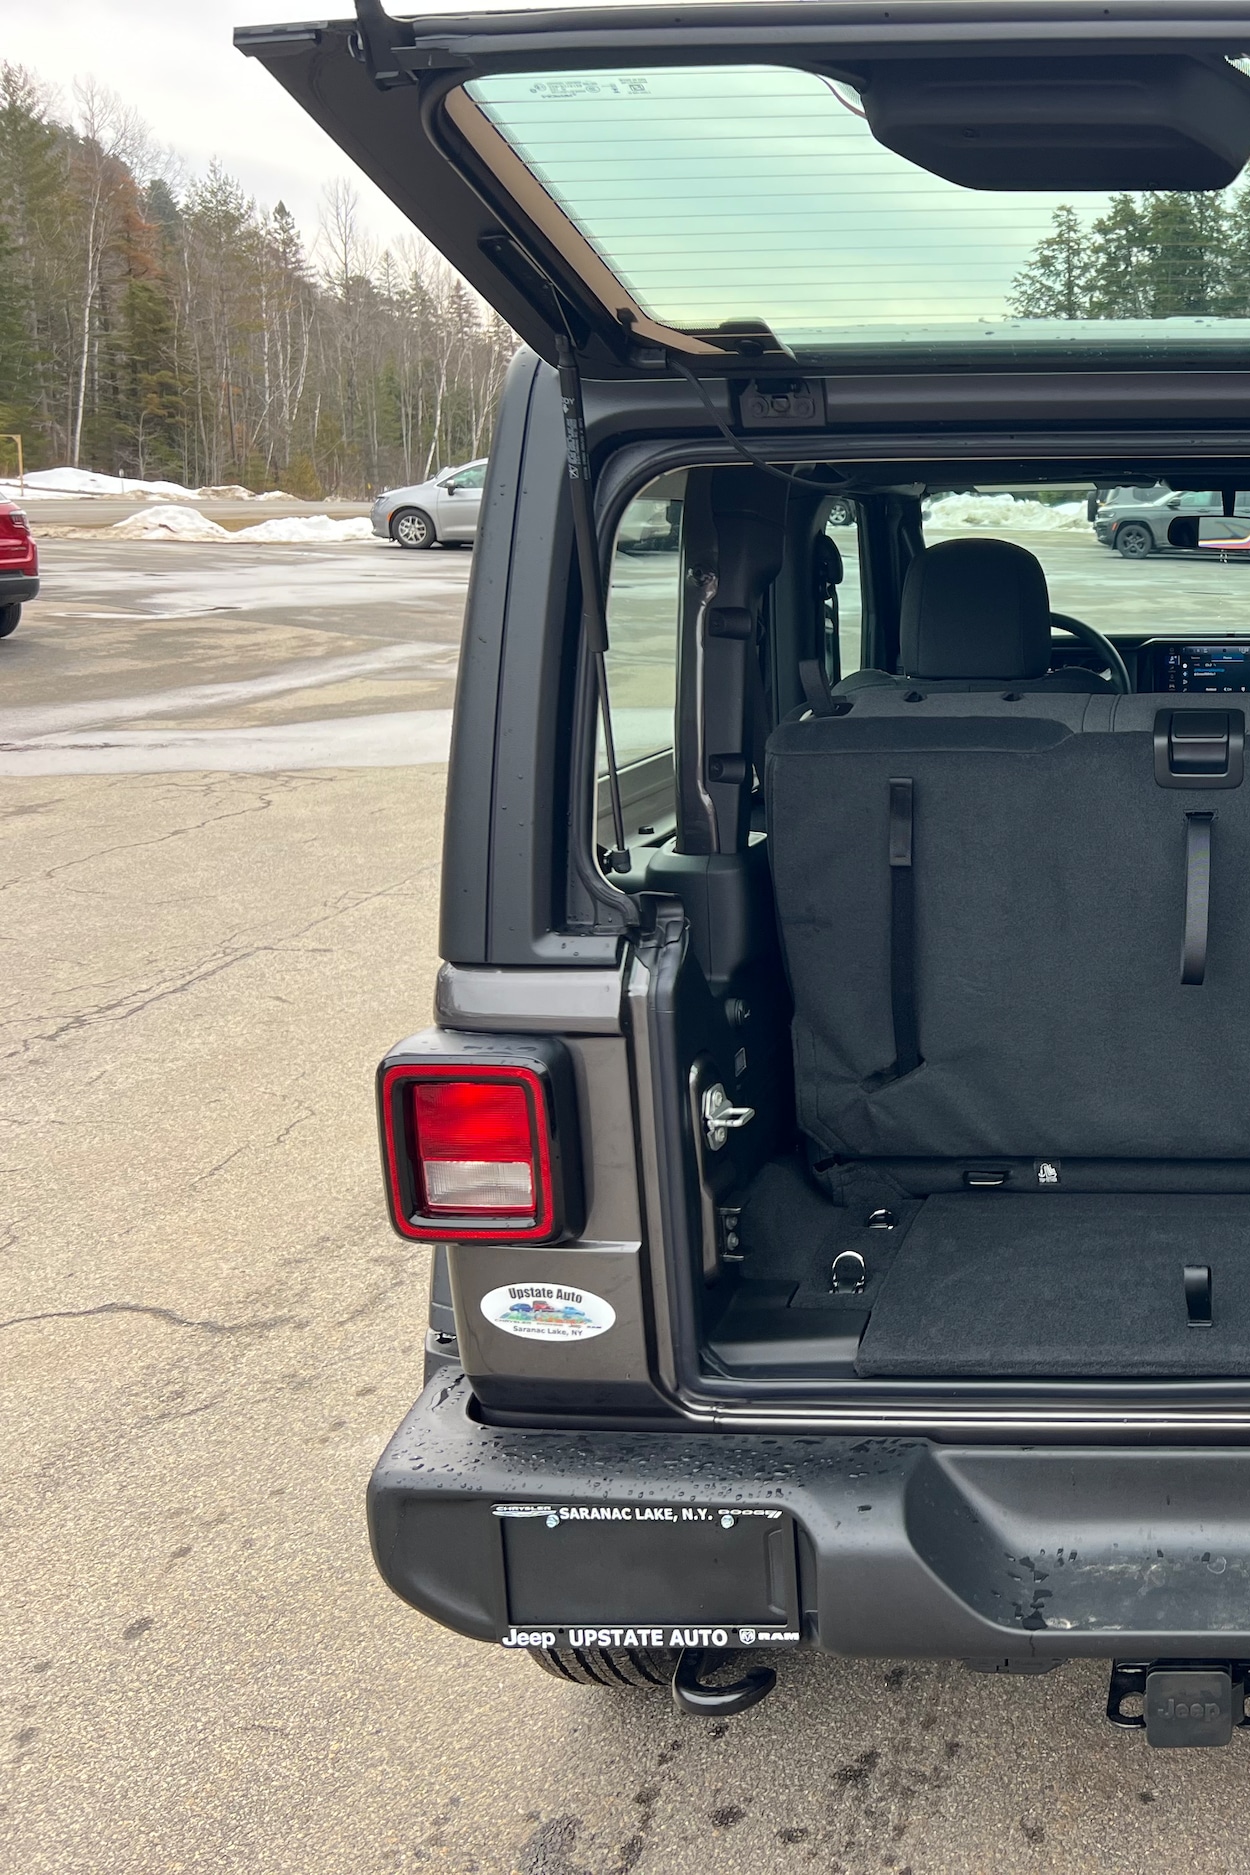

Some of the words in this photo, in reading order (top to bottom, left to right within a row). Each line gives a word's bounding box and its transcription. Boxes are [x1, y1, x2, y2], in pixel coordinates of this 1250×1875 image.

[508, 1287, 554, 1300] Upstate
[556, 1288, 583, 1304] Auto
[513, 1325, 546, 1334] Saranac
[547, 1327, 569, 1336] Lake,
[559, 1506, 632, 1520] SARANAC
[636, 1508, 678, 1522] LAKE,
[682, 1508, 713, 1521] N.Y.
[502, 1628, 556, 1648] Jeep
[569, 1629, 664, 1646] UPSTATE
[669, 1629, 728, 1646] AUTO
[758, 1631, 799, 1641] RAM
[1157, 1698, 1221, 1722] Jeep
